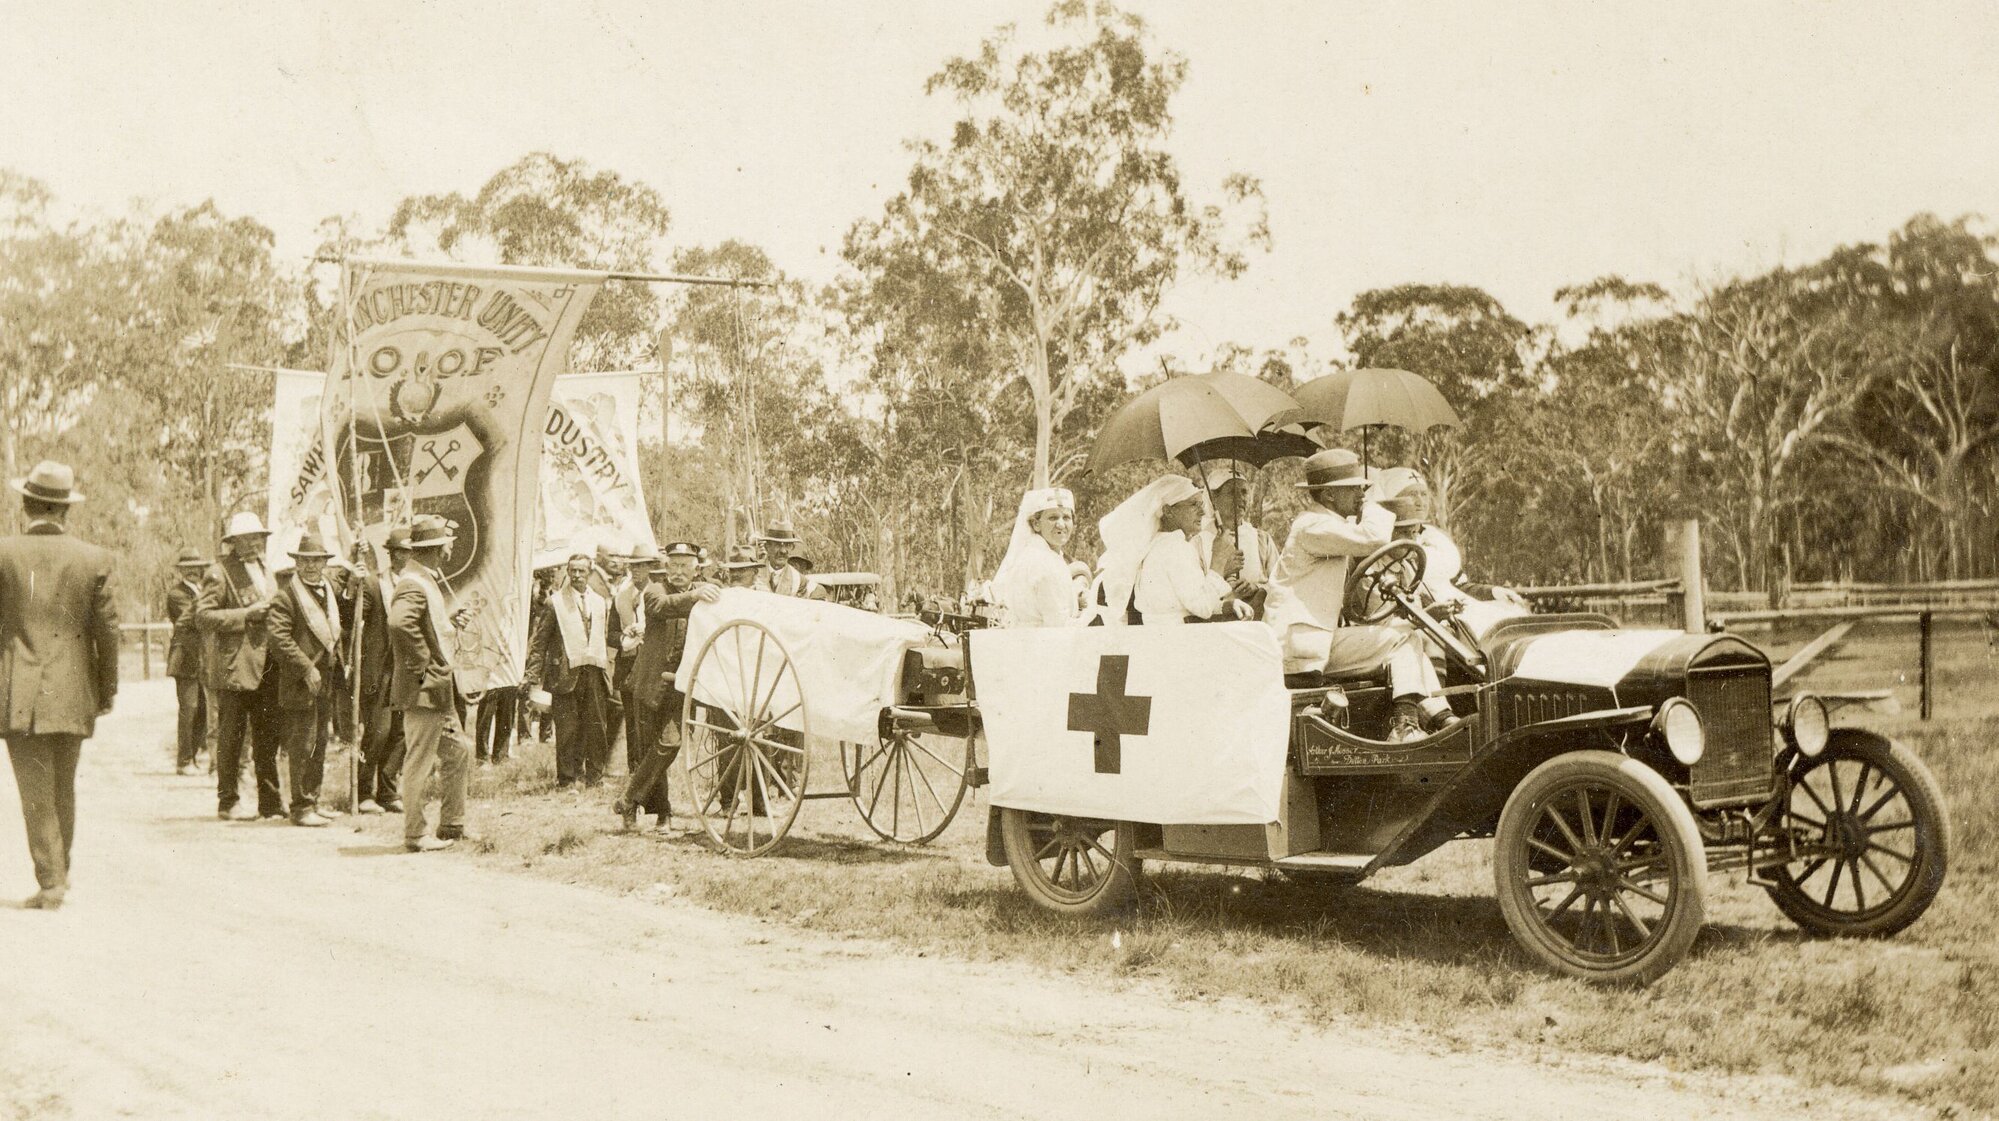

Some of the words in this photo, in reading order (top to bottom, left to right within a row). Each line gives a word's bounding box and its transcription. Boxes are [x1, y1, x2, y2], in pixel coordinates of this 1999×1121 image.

[336, 281, 483, 346] NCHESTER
[476, 288, 549, 354] UNITY
[543, 405, 629, 495] DUSTRY
